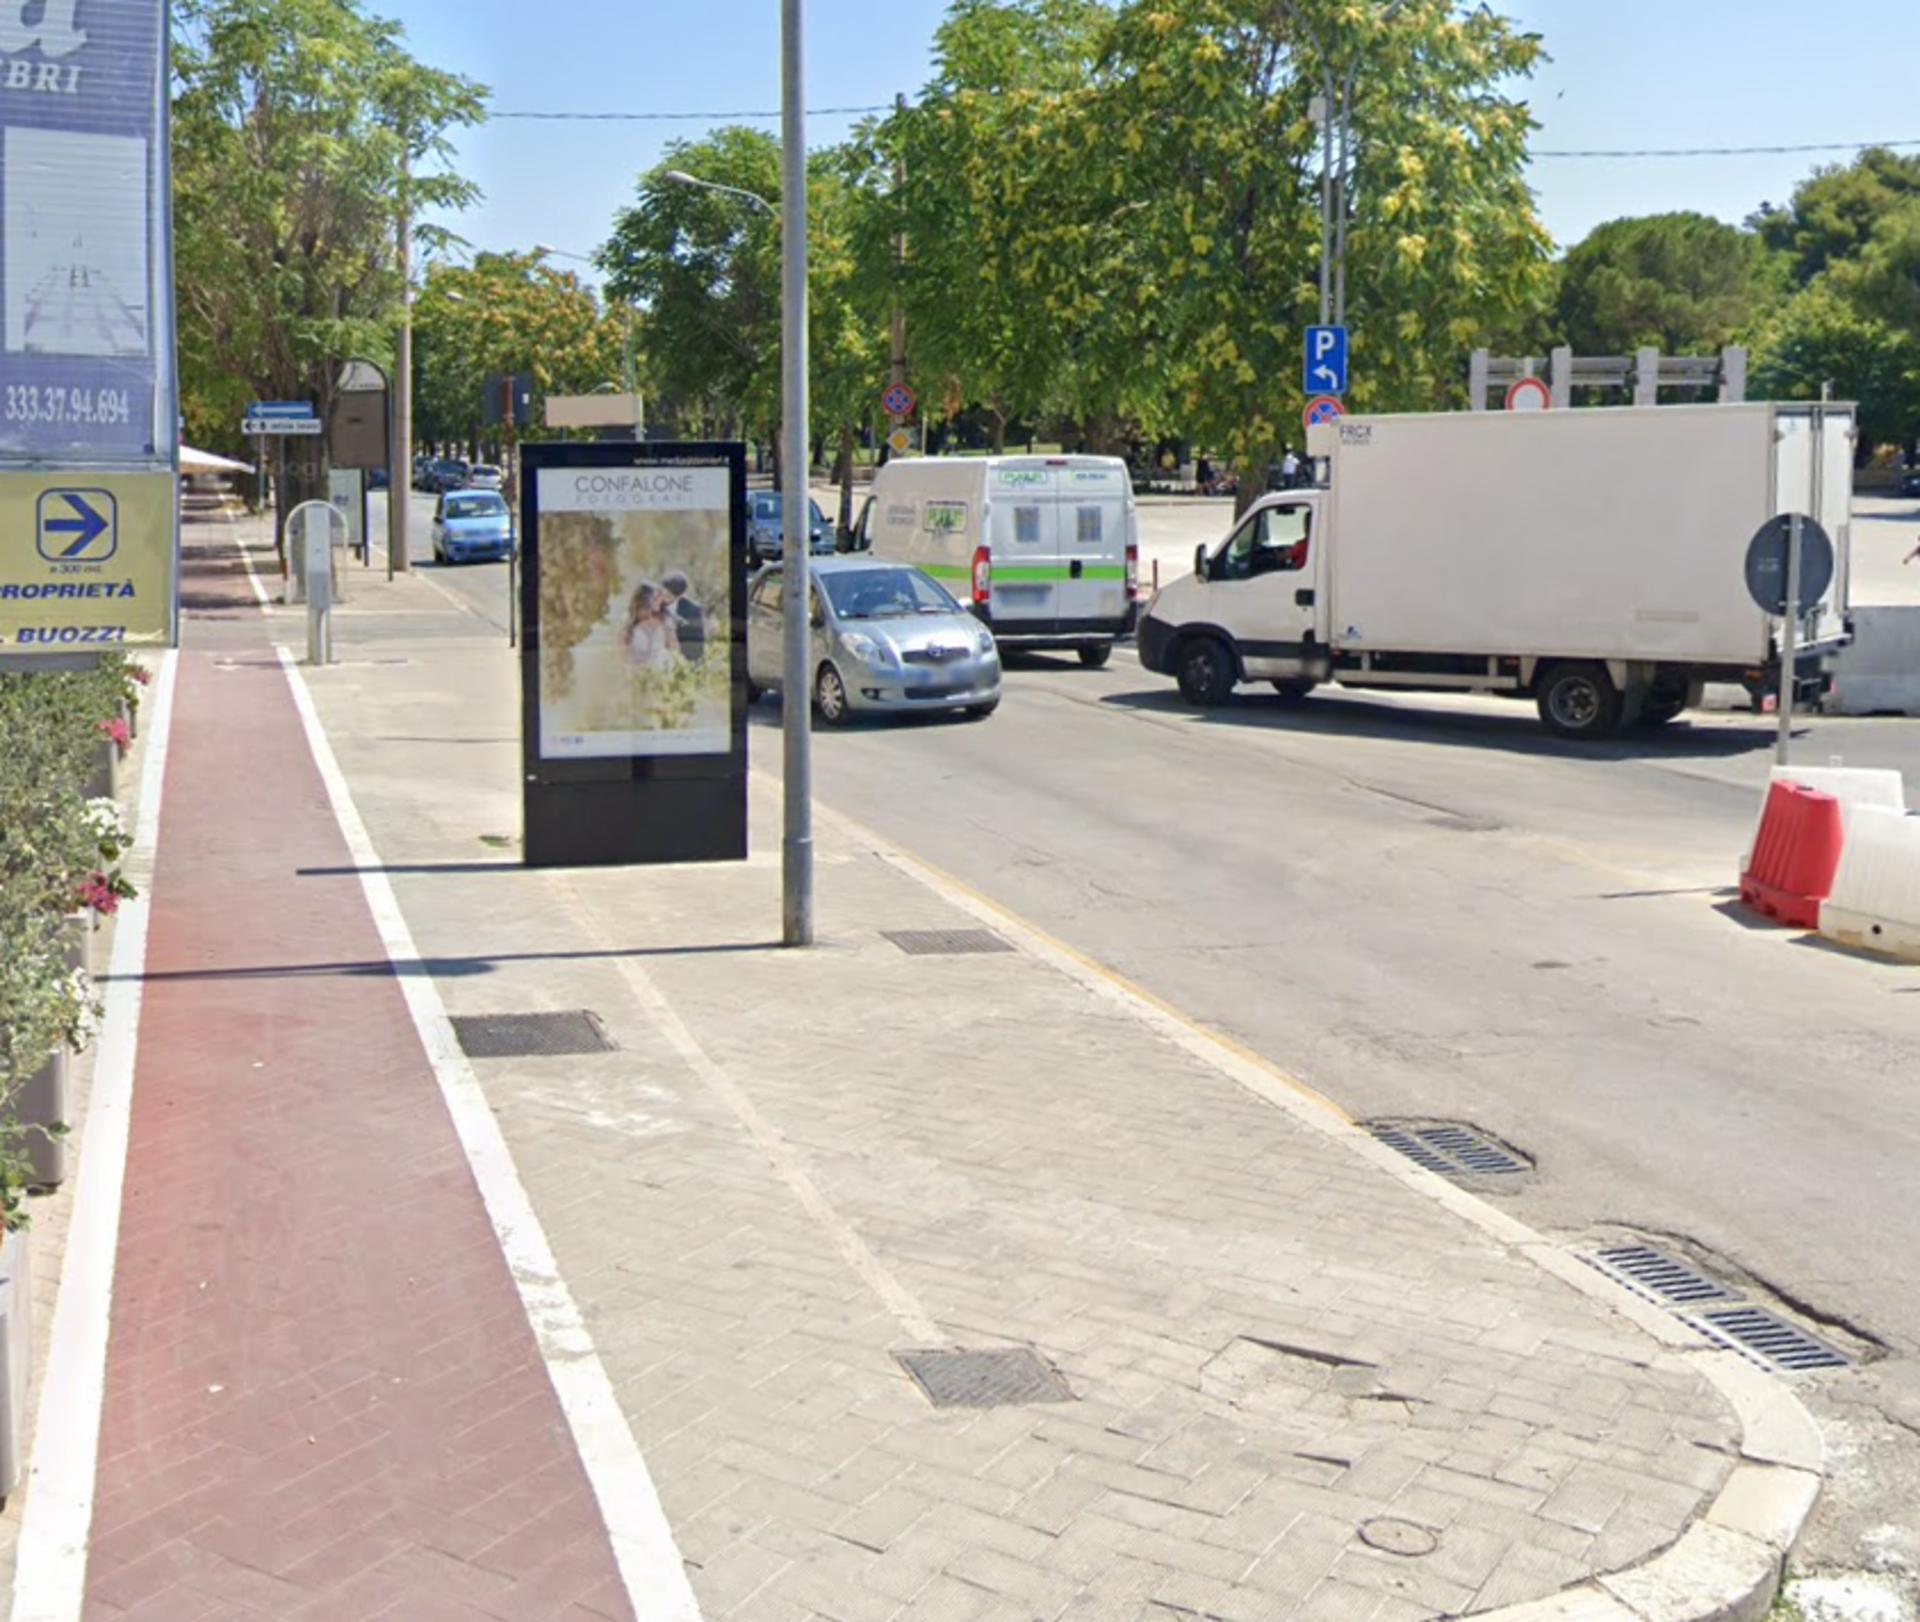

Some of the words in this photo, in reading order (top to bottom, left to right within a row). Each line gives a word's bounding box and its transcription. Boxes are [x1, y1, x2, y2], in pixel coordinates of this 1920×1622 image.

[0, 59, 83, 95] BRI
[1316, 330, 1335, 360] P
[5, 385, 130, 424] 333.37.94.694
[574, 475, 694, 494] CONFALONE
[0, 578, 136, 599] ROPRIETÀ
[16, 626, 127, 643] BUOZZI
